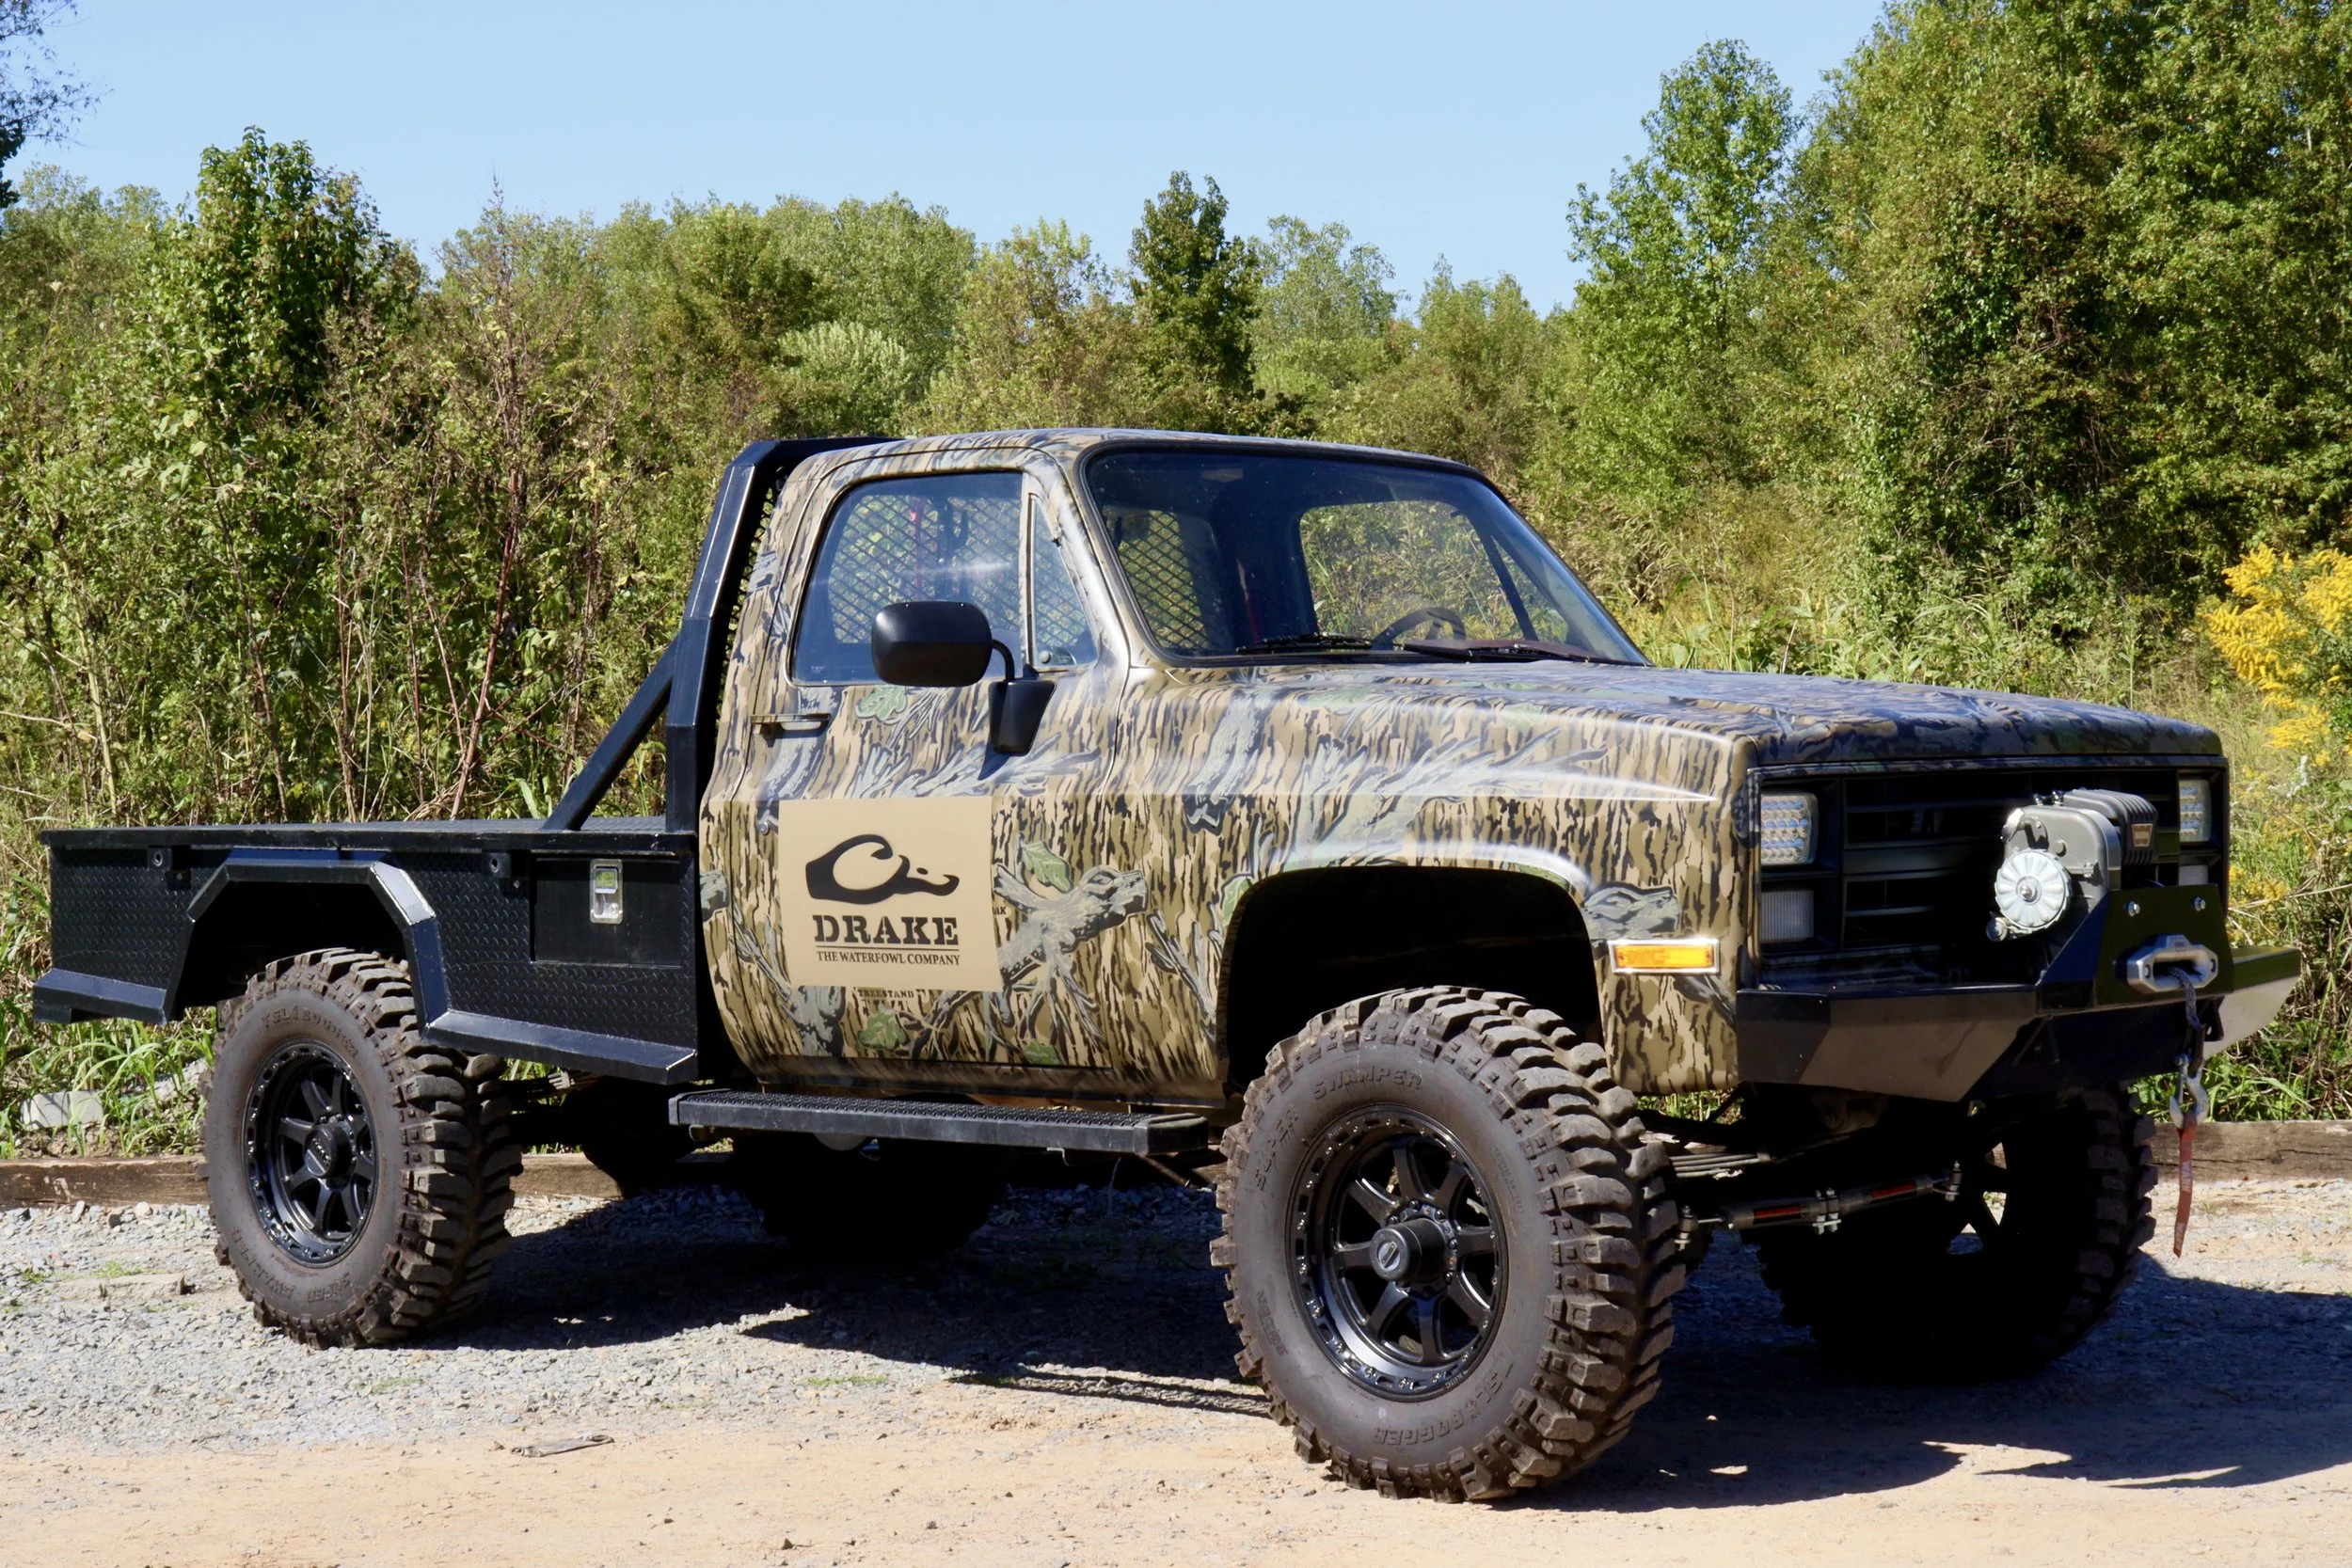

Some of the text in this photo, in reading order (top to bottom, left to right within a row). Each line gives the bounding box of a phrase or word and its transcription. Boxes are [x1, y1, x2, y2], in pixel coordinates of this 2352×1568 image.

[812, 914, 959, 945] DRAKE
[817, 950, 961, 965] THE WATERFOWL COMPANY
[856, 989, 914, 999] TREESTAND
[1312, 1064, 1423, 1101] SWAMPER
